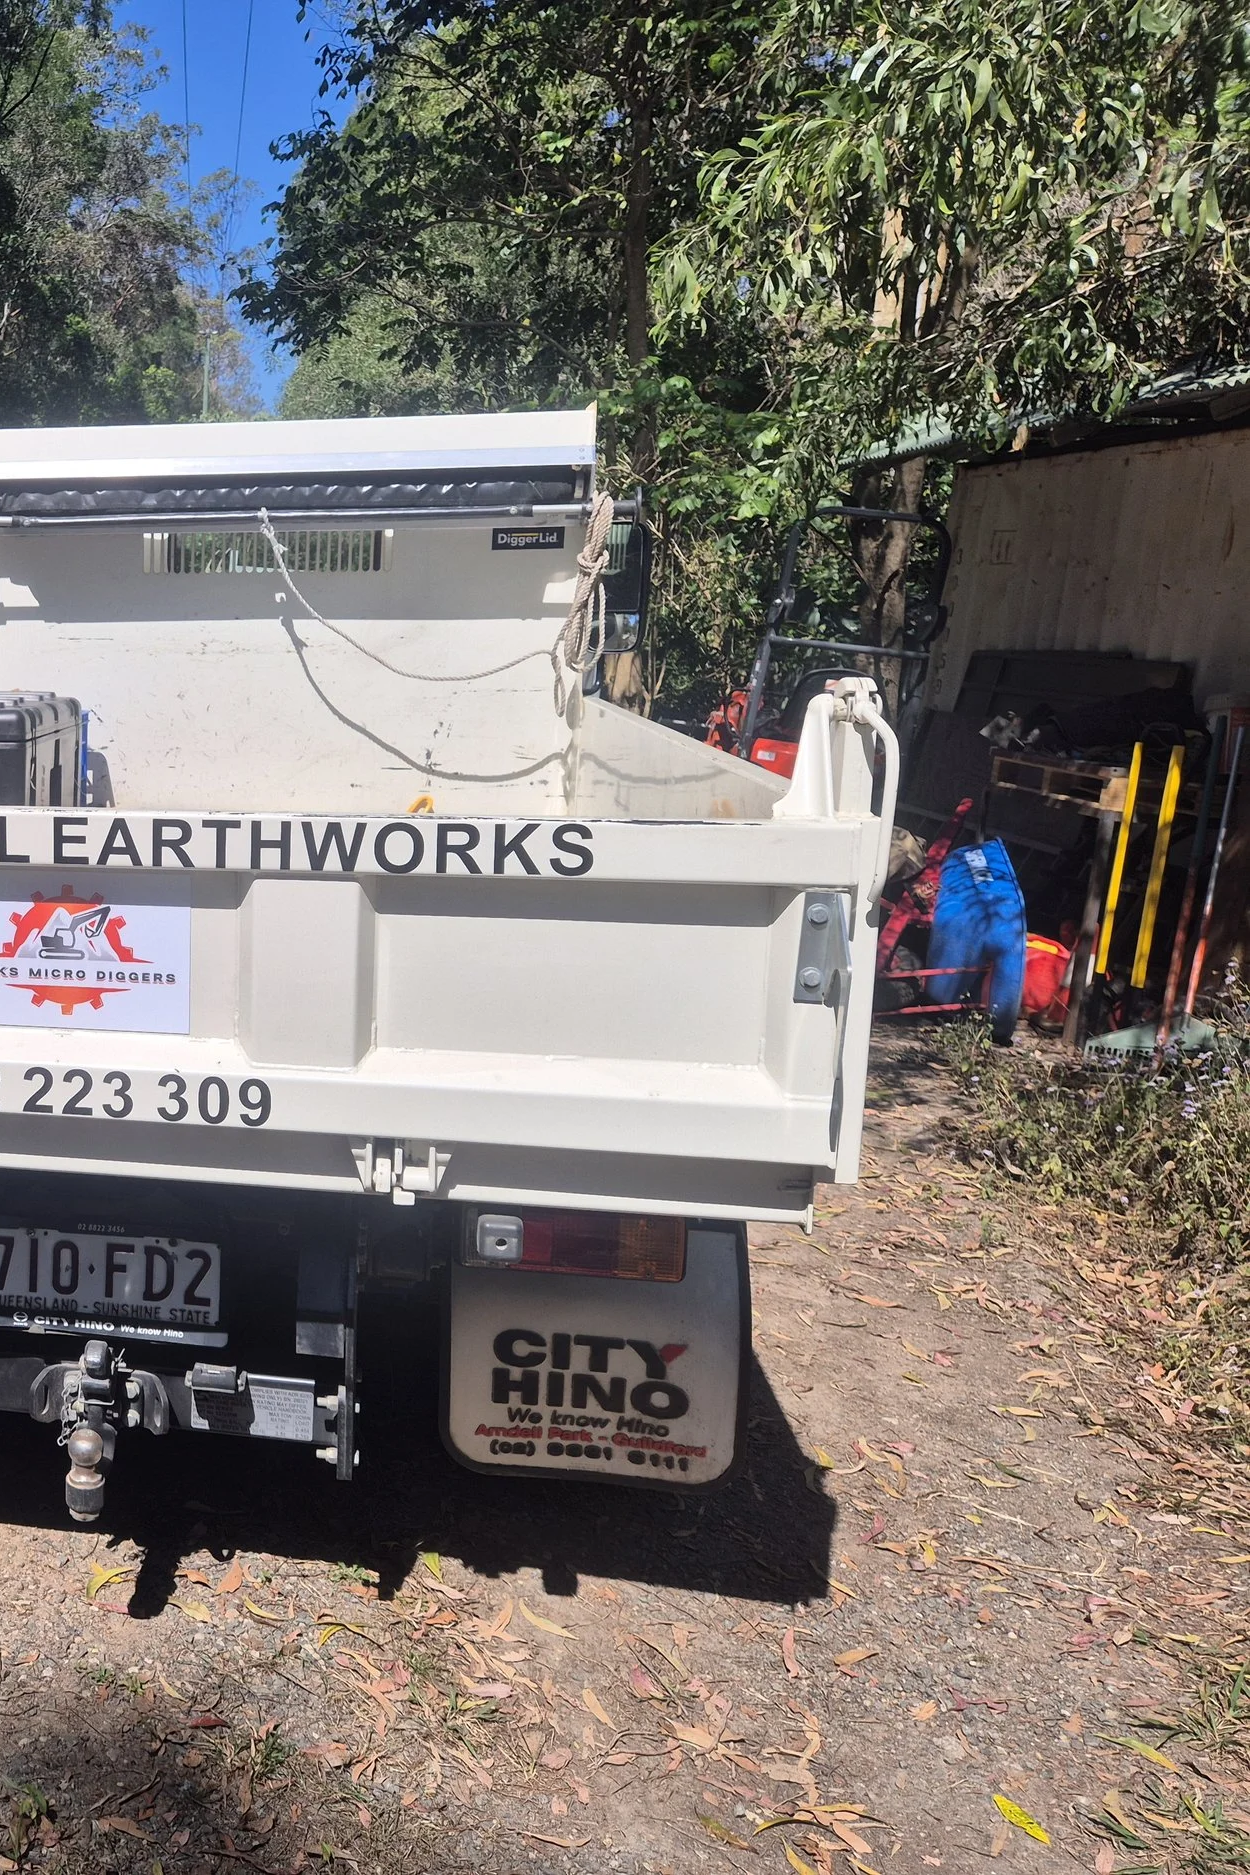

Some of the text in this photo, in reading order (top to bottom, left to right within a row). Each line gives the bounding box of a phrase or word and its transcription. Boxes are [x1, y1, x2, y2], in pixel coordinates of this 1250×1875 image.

[497, 532, 557, 547] DiggerLid
[52, 817, 594, 877] EARTHWORKS
[28, 967, 86, 980] MICRO
[96, 970, 176, 985] DIGGERS
[22, 1067, 134, 1118] 223
[157, 1073, 272, 1127] 309
[33, 1315, 184, 1338] CITY HINO We know Hino
[92, 1302, 161, 1321] SUNSHINE
[169, 1308, 210, 1325] STATE
[493, 1328, 689, 1380] CITY
[491, 1367, 690, 1420] HINO
[507, 1406, 670, 1437] We know Hino
[547, 1426, 594, 1443] Park
